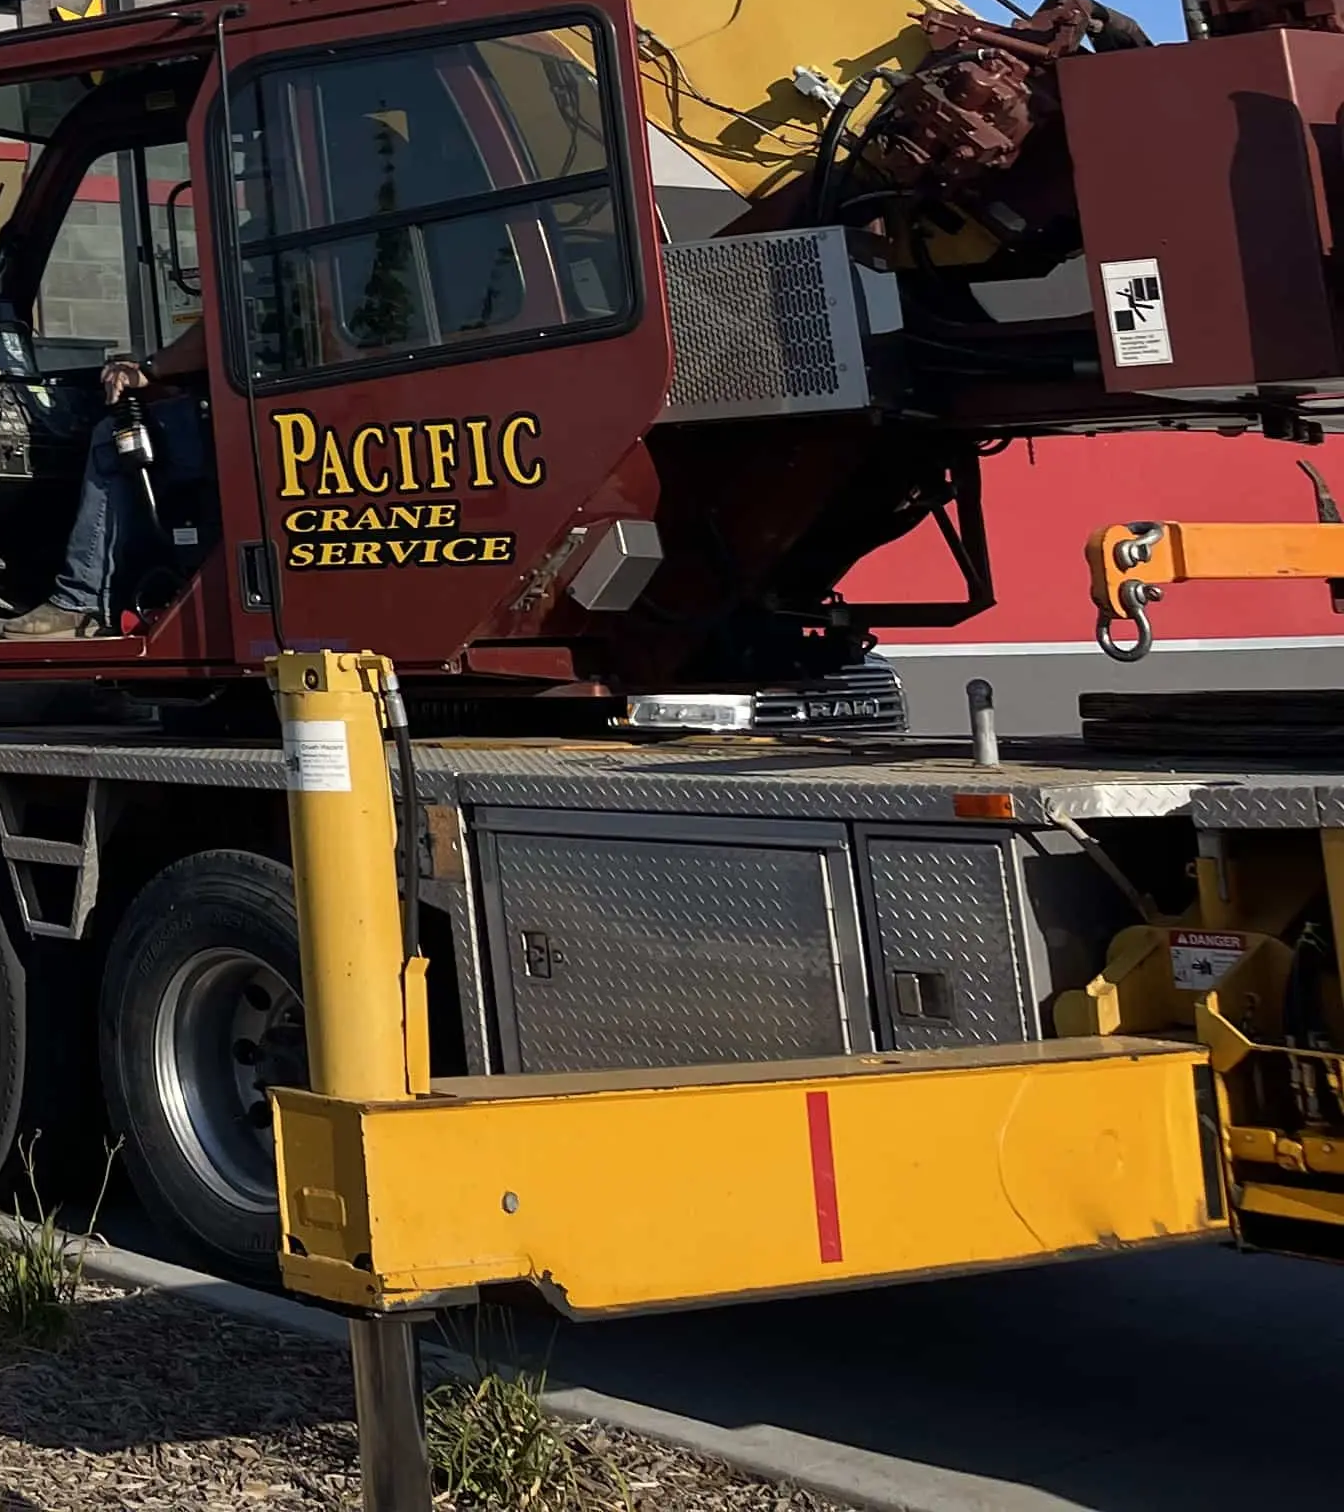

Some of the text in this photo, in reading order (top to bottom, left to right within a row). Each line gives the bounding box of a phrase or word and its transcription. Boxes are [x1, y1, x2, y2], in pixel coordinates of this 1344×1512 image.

[285, 503, 456, 534] CRANE
[289, 536, 512, 567] SERVICE
[809, 699, 880, 719] RAM
[1188, 934, 1241, 948] DANGER
